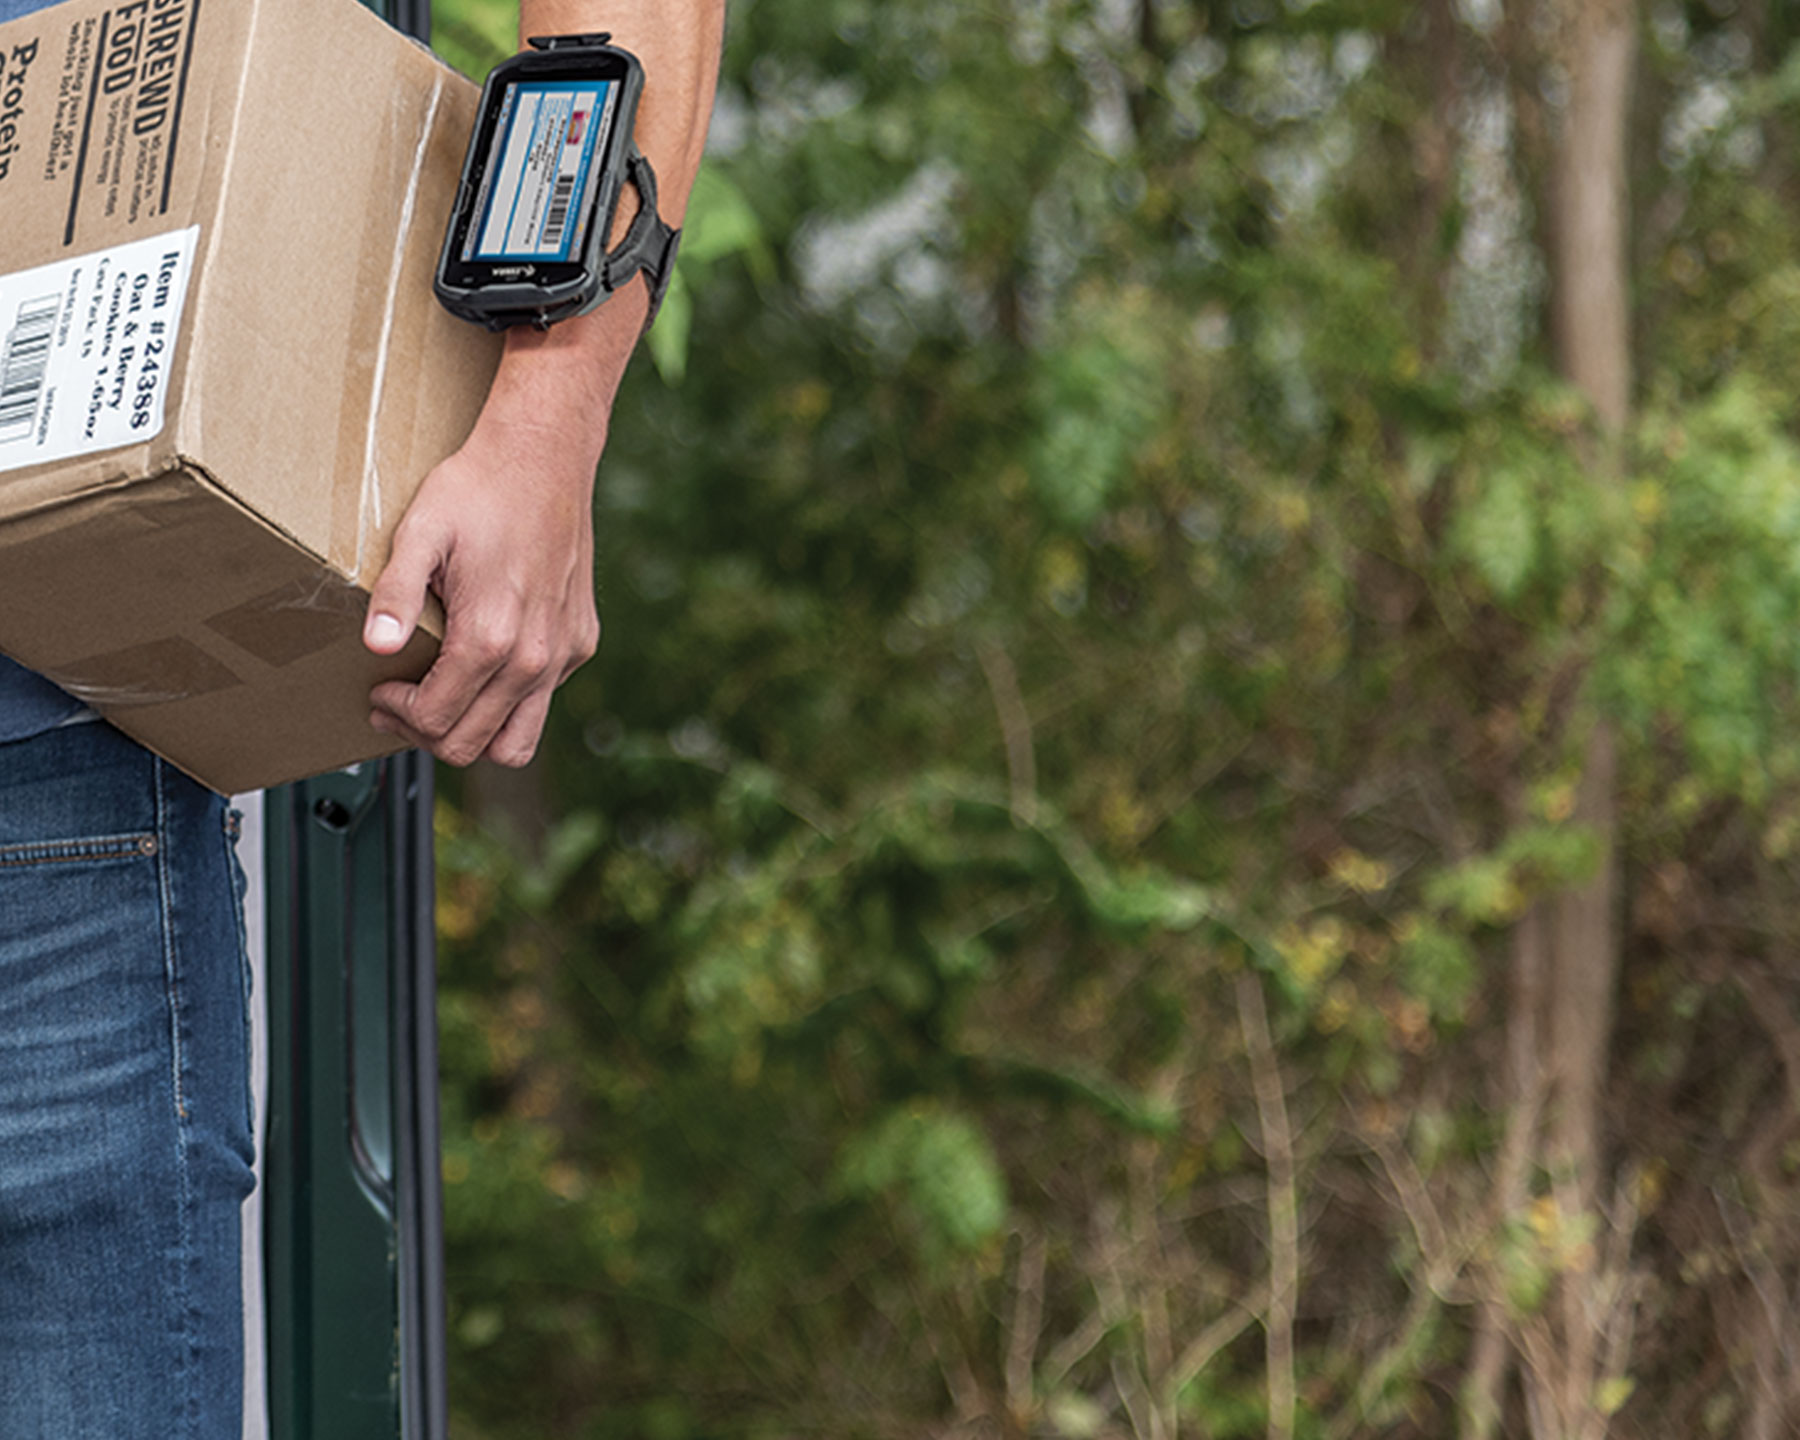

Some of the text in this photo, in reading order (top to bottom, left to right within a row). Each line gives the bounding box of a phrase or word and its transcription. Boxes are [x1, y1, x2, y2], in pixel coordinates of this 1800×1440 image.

[44, 21, 80, 180] whole lot healthier!
[59, 17, 96, 170] Snacking just got a
[95, 257, 110, 289] Case
[108, 273, 148, 409] Oat & Berry
[130, 251, 179, 429] Item #24388
[85, 271, 126, 437] Cookies 1.65oz
